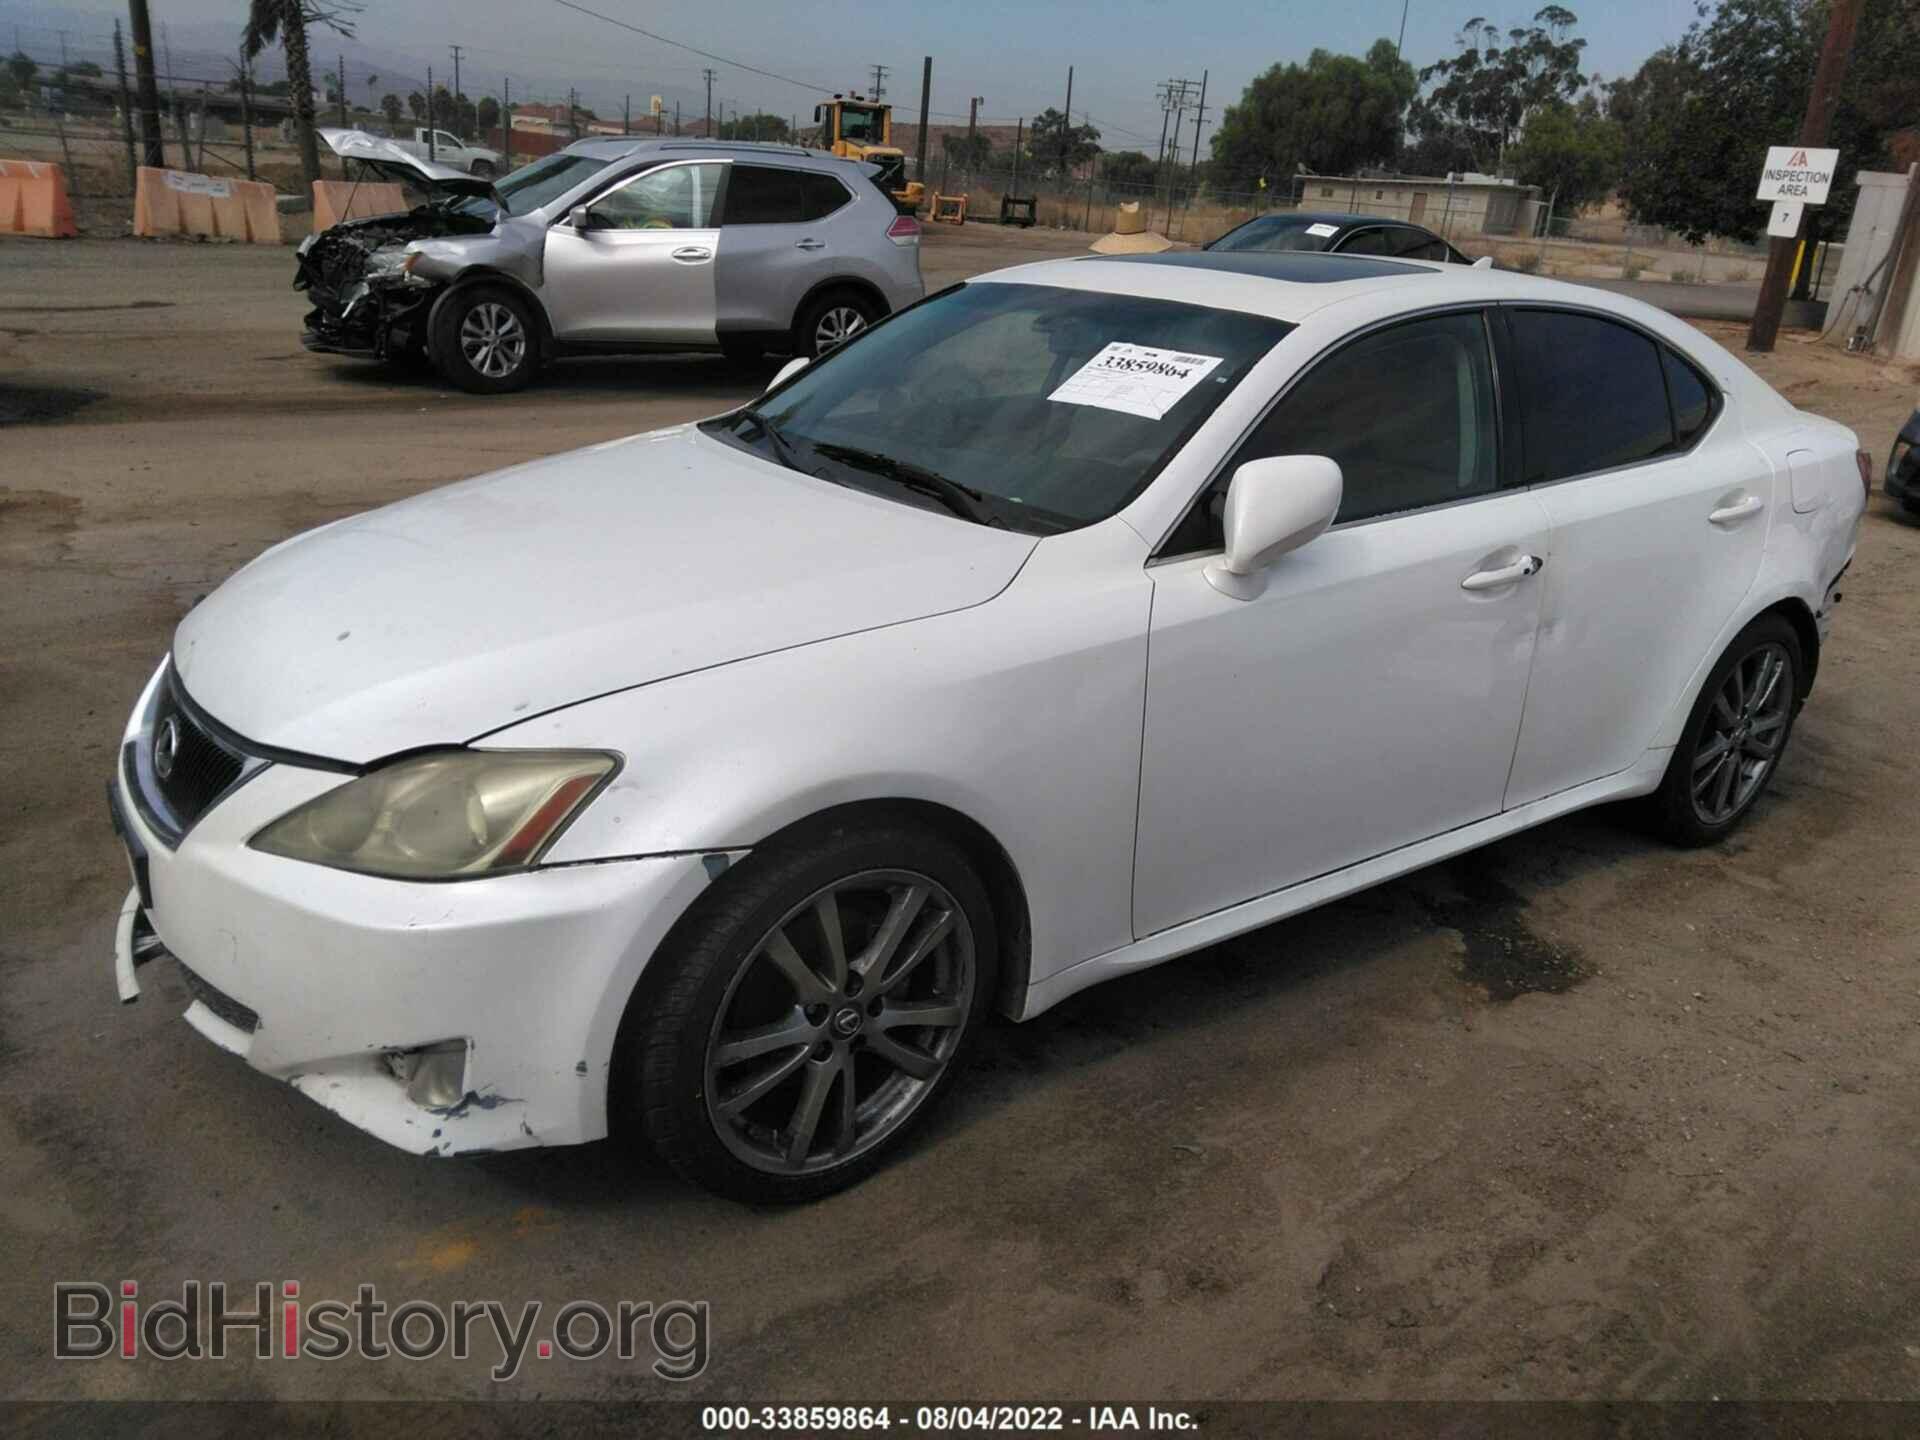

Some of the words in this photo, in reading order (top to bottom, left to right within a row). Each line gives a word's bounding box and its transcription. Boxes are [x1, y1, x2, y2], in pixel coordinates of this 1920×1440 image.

[1763, 169, 1830, 184] INSPECTION
[1777, 184, 1808, 197] AREA
[1782, 212, 1790, 223] 7
[1097, 355, 1193, 379] 33859864
